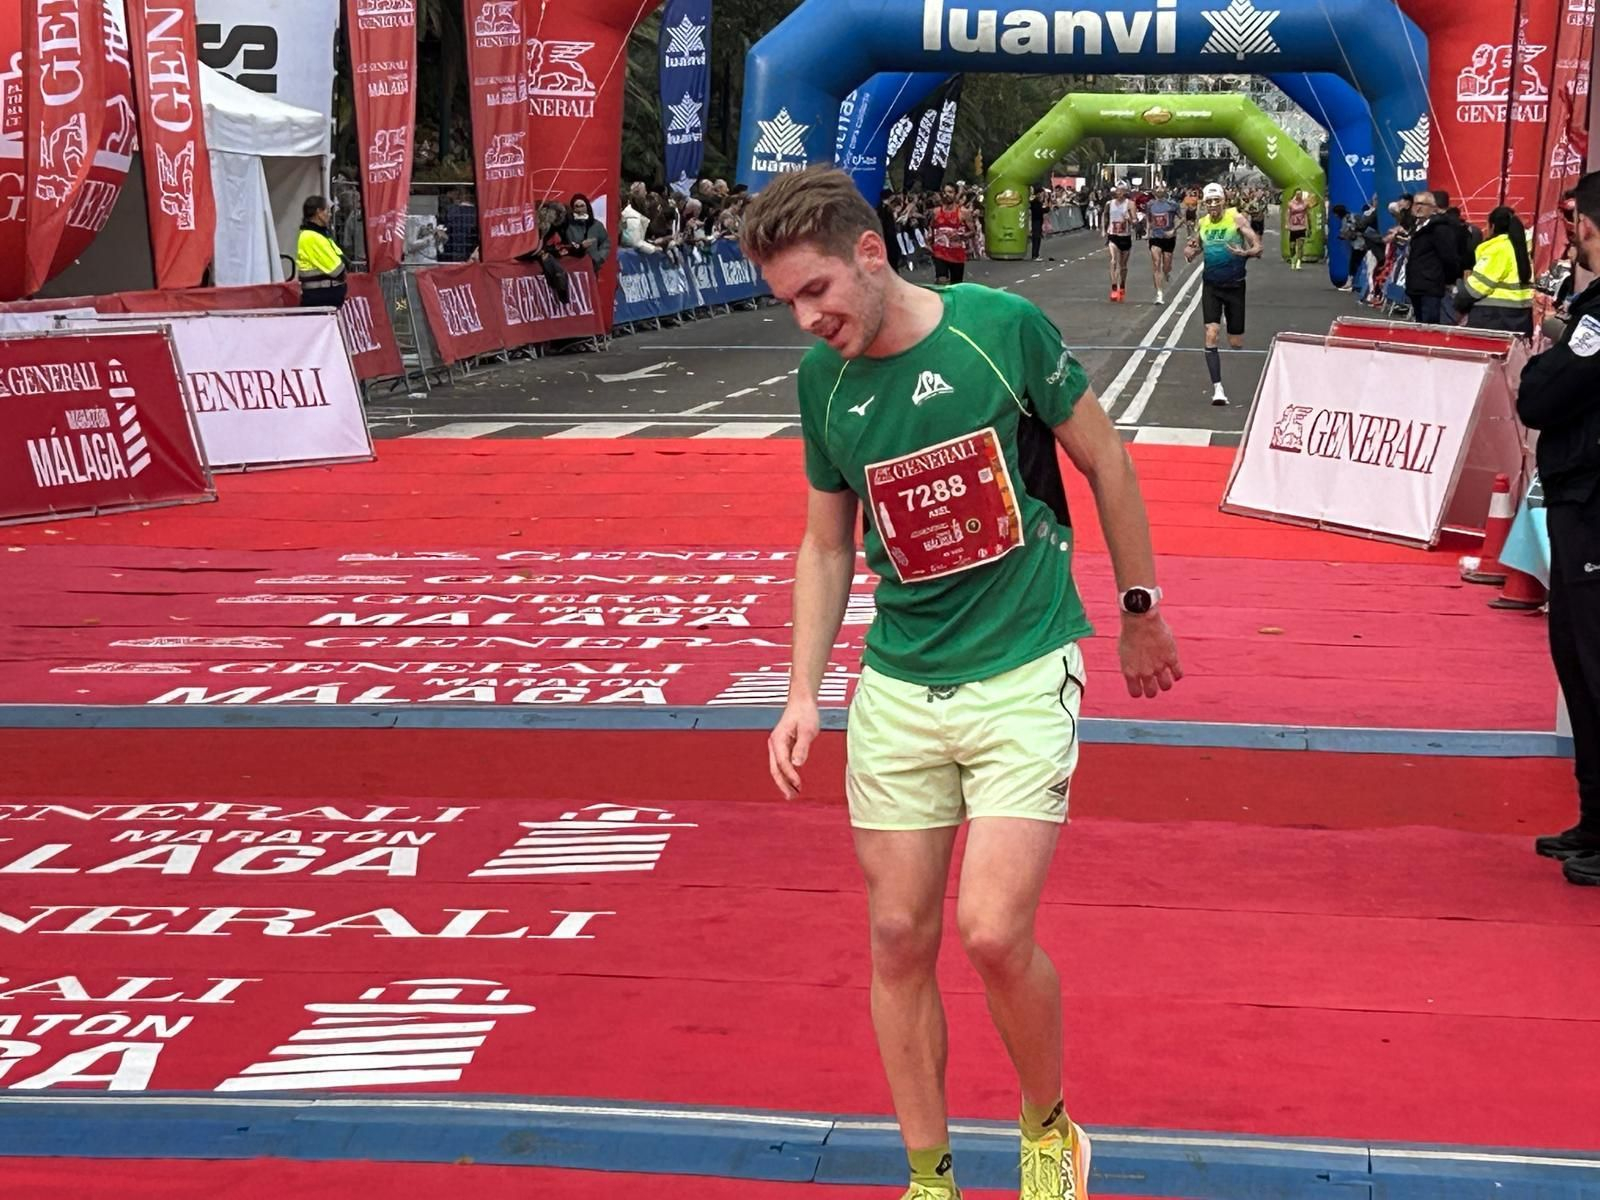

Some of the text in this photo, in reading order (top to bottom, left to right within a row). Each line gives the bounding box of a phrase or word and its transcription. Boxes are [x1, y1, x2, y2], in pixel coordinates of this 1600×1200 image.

[923, 0, 1178, 54] luanvi
[37, 0, 83, 106] GE
[145, 0, 193, 132] GEN
[527, 98, 595, 118] NERALI
[8, 361, 102, 396] GENERALI
[183, 367, 332, 413] ENERALI
[27, 427, 128, 488] MÁLAGA
[893, 439, 978, 479] GENERALI
[1308, 410, 1446, 474] GENERALI
[898, 474, 967, 511] 7288
[352, 594, 768, 605] GENERALI
[304, 636, 797, 648] GENERA
[209, 661, 694, 674] GENERALI
[0, 975, 263, 1004] ALI
